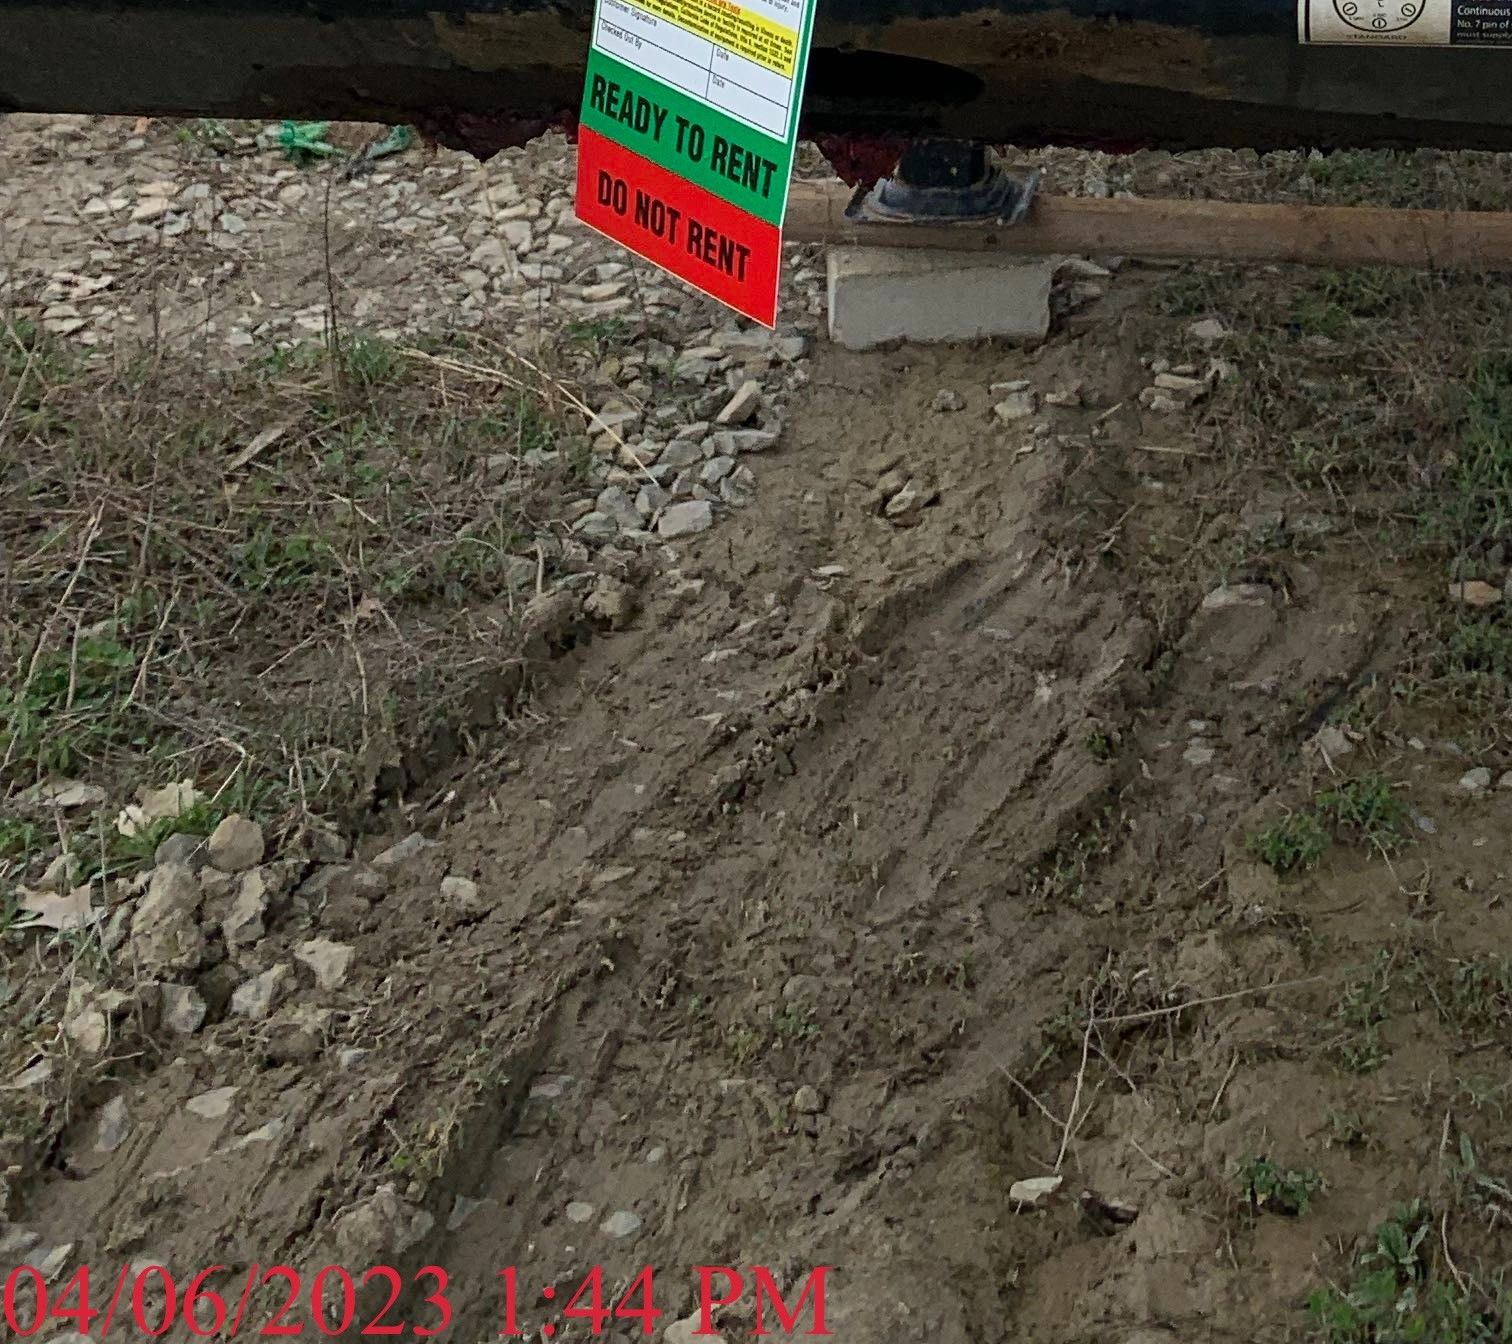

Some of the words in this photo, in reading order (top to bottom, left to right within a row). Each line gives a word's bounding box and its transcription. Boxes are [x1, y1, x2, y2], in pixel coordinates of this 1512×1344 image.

[1457, 5, 1510, 17] Continuous
[590, 74, 667, 140] READY
[676, 116, 704, 161] TO
[711, 136, 776, 197] RENT
[598, 170, 626, 215] DO
[635, 189, 680, 243] NOT
[687, 218, 749, 281] RENT
